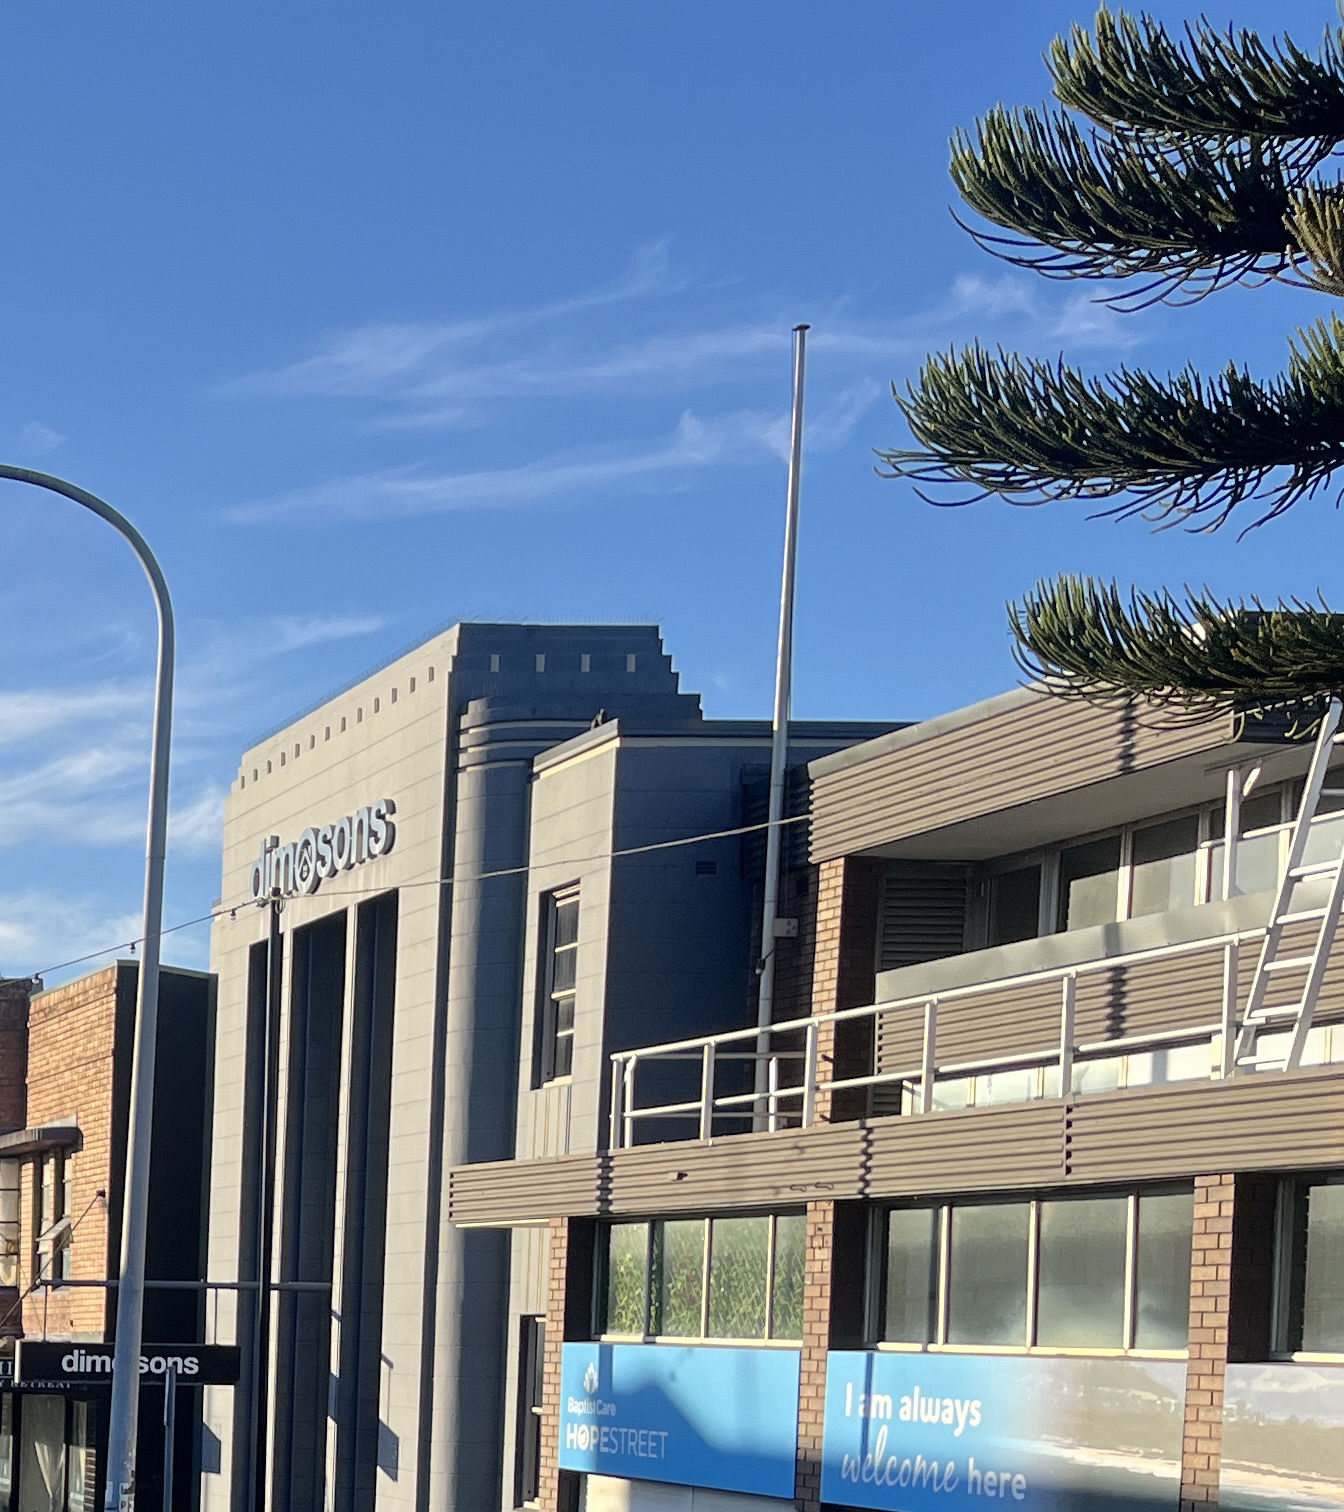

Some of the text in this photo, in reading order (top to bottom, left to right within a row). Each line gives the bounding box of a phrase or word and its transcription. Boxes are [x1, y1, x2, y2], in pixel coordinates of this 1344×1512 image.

[62, 1349, 199, 1375] dimsons
[845, 1381, 982, 1437] I am always
[841, 1424, 1027, 1500] welcome here
